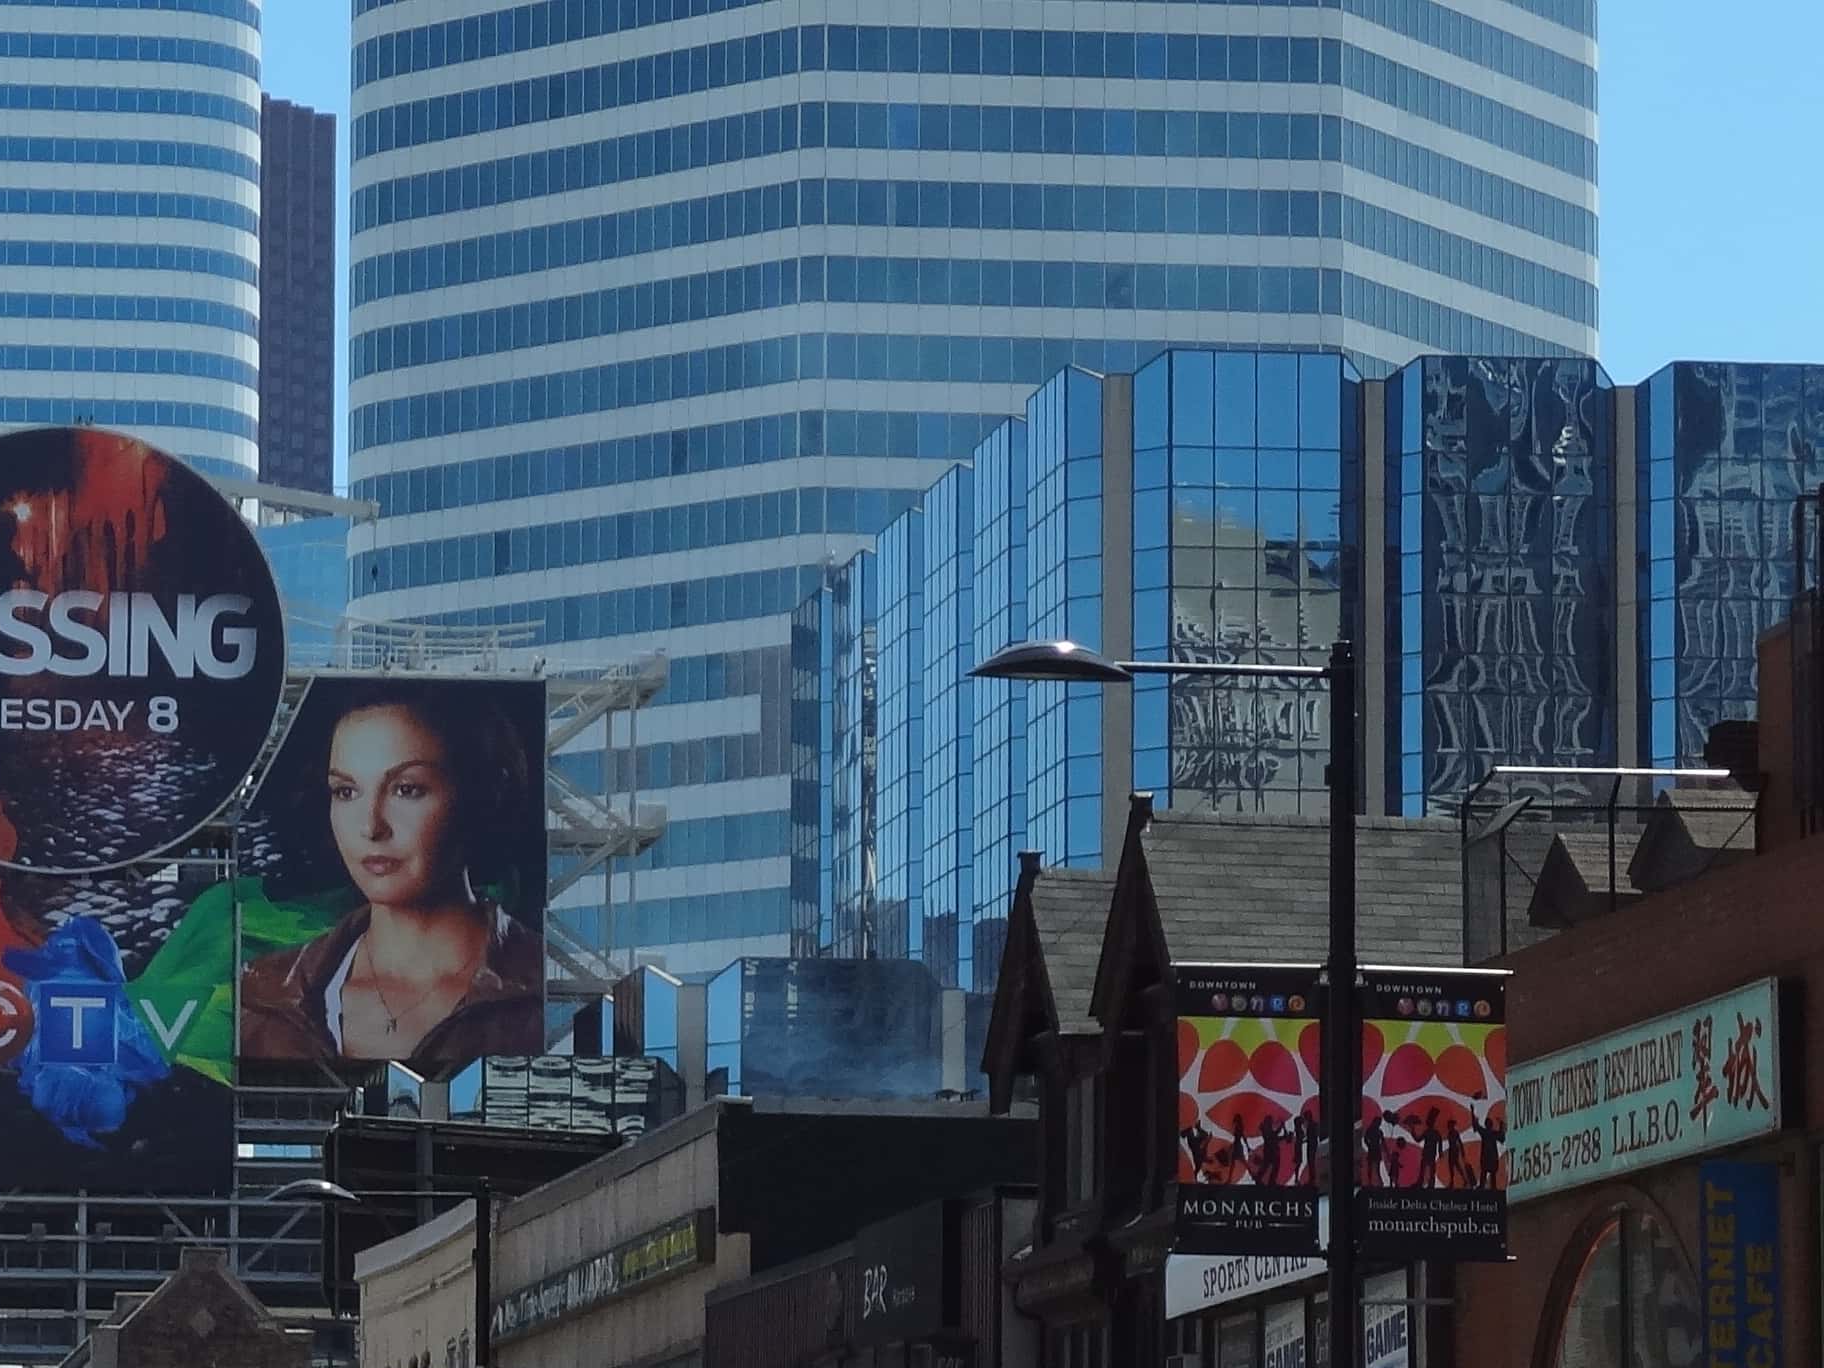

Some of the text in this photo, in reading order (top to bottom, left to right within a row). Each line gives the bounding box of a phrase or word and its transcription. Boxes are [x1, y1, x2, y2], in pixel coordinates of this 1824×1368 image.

[147, 696, 179, 733] 8
[1188, 979, 1257, 990] DOWNTOWN
[1375, 983, 1443, 995] DOWNTOWN
[1512, 1029, 1683, 1130] TOWN CHINESE RESTAURANT
[1183, 1199, 1313, 1217] MONARCHS
[1369, 1198, 1398, 1210] Inside
[1401, 1199, 1427, 1211] Delta
[1470, 1200, 1498, 1212] Hotel
[1235, 1219, 1264, 1230] PUB
[1369, 1217, 1500, 1237] monarchspub.ca
[1203, 1256, 1250, 1299] SPORTS
[1366, 1310, 1407, 1365] GAME
